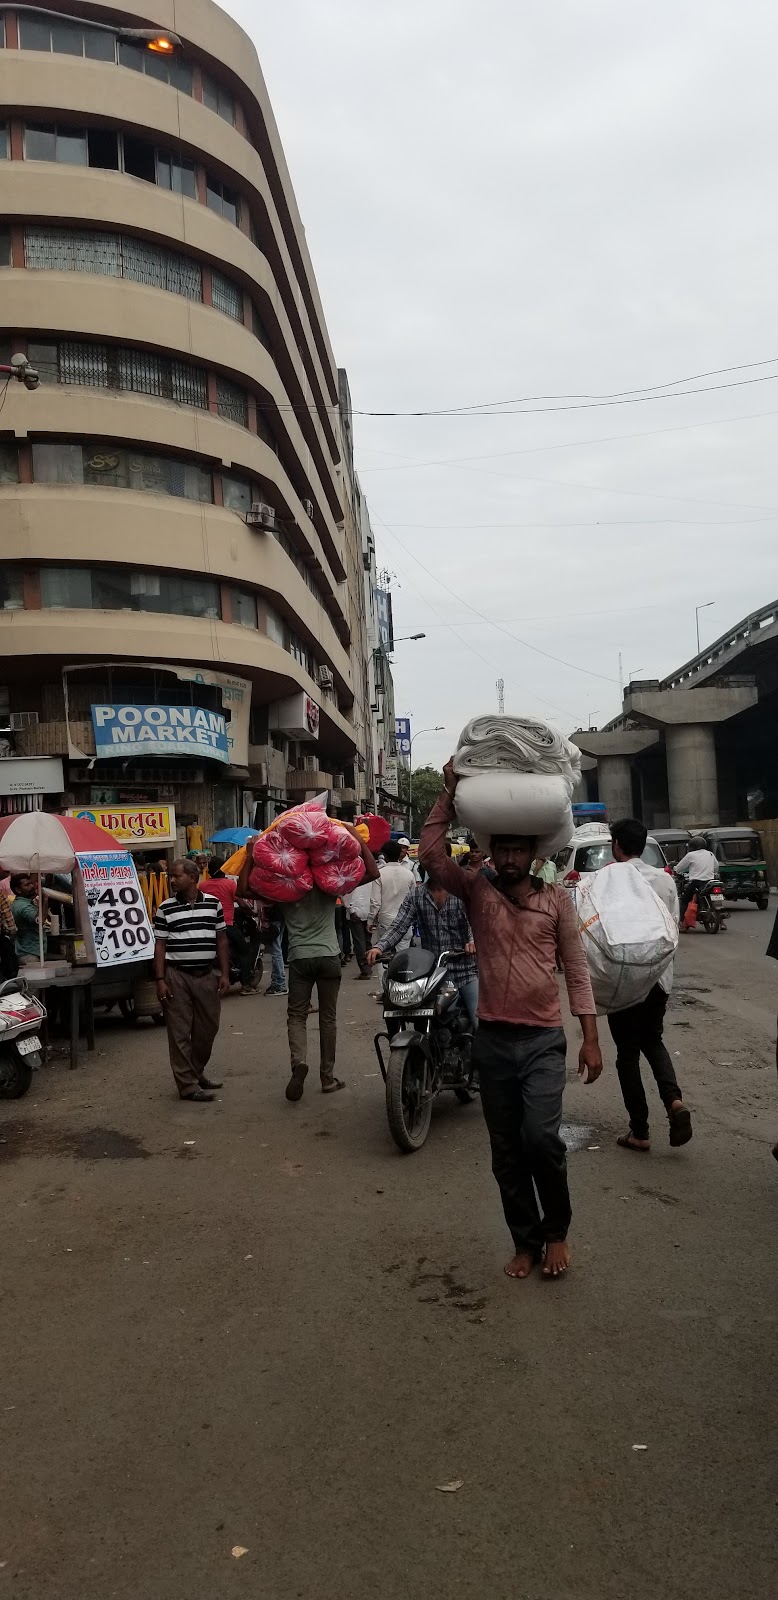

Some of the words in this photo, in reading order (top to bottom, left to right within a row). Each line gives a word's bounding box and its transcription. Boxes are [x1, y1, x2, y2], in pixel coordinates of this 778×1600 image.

[95, 706, 225, 735] POONAM
[111, 725, 219, 747] MARKET
[104, 743, 142, 755] RING
[100, 812, 165, 838] फालुदा
[98, 887, 139, 907] 40
[102, 907, 145, 928] 80
[107, 926, 151, 949] 100
